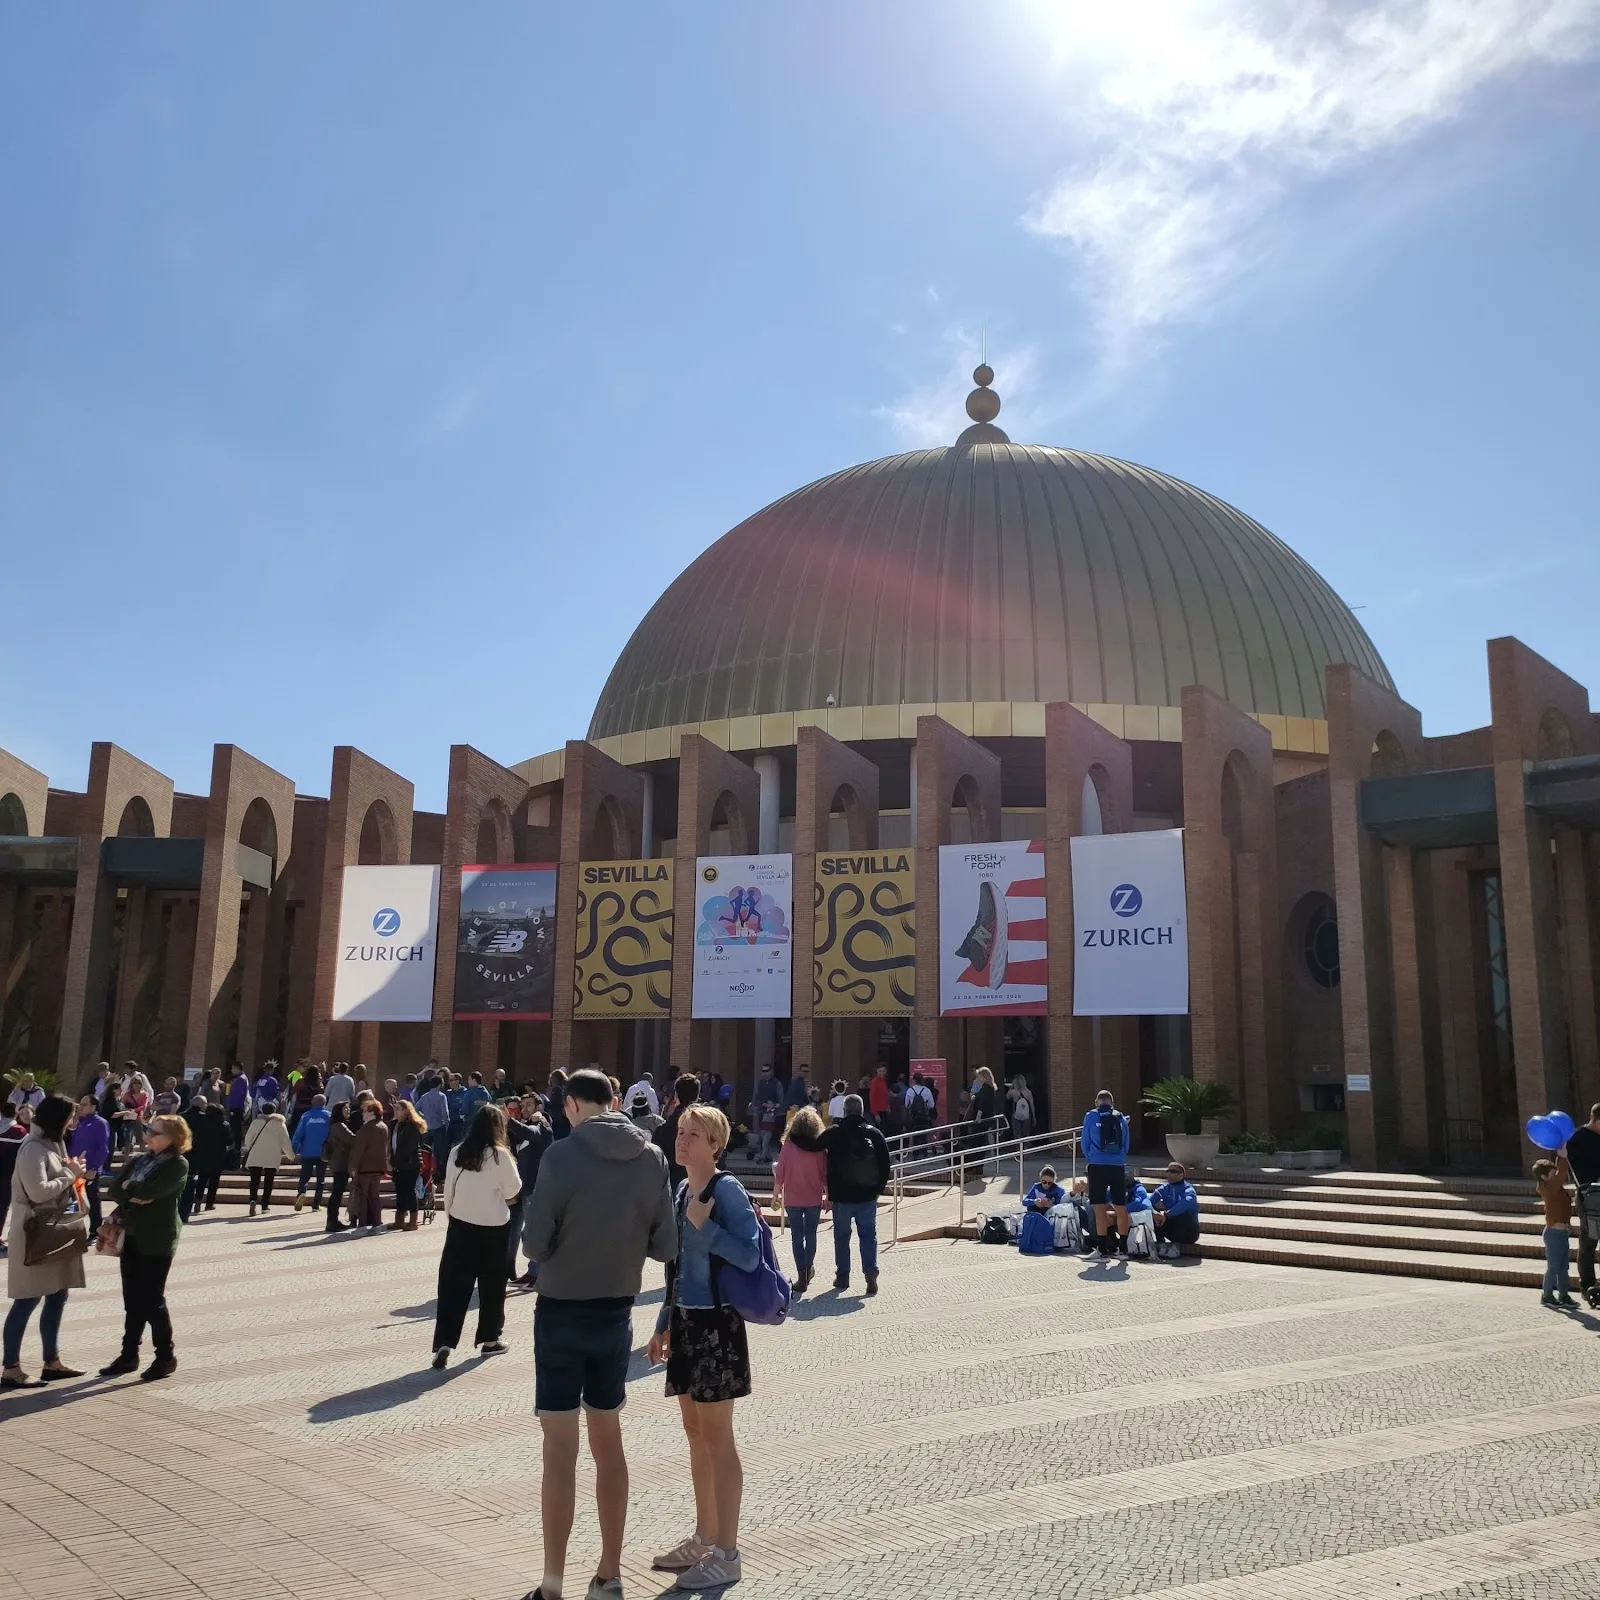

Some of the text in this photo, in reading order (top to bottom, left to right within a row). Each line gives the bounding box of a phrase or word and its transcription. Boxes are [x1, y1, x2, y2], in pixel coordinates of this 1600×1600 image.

[821, 855, 910, 875] SEVILLA
[964, 853, 997, 862] FRESH
[971, 861, 1002, 870] FOAM
[584, 865, 669, 884] SEVILLA
[487, 901, 518, 914] GOT
[1083, 926, 1173, 948] ZURICH
[344, 946, 423, 962] ZURICH
[475, 963, 534, 983] SEVILLA
